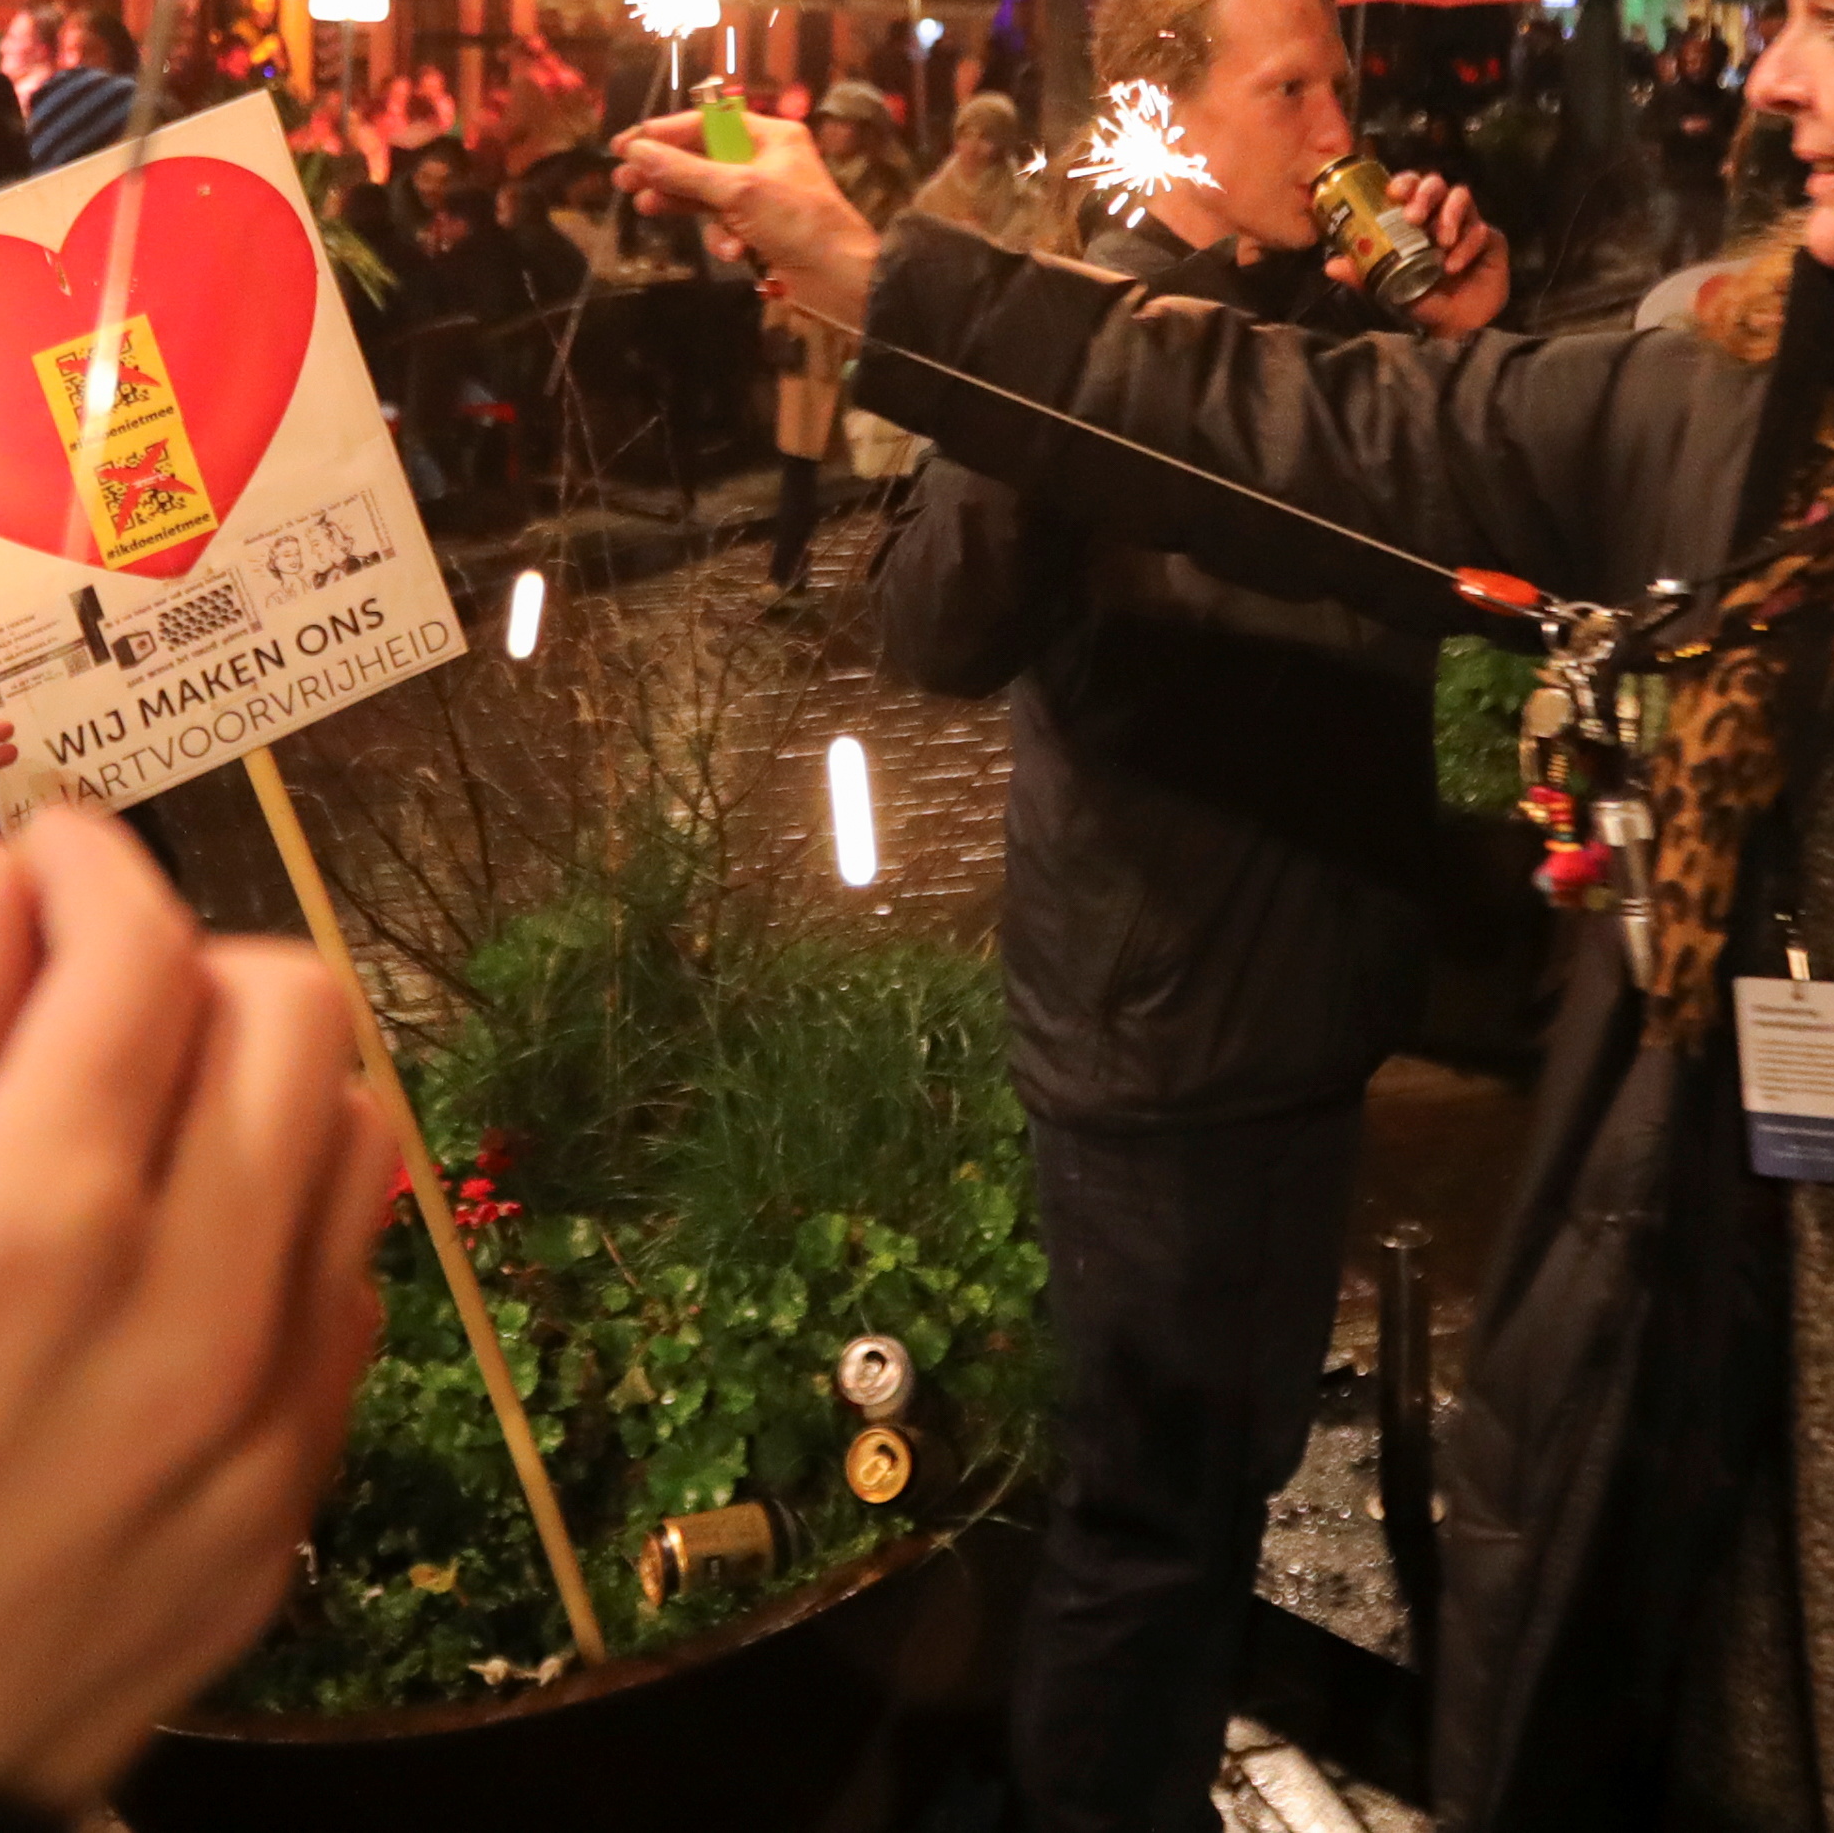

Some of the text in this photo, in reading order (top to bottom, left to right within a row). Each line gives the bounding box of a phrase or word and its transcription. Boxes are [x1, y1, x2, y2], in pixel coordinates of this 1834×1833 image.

[106, 512, 212, 560] #ikdoenietmee
[9, 619, 452, 824] #ARTVOORVRIJHEID
[43, 709, 127, 766] WIJ
[137, 637, 287, 730] MAKEN
[295, 597, 386, 657] ONS
